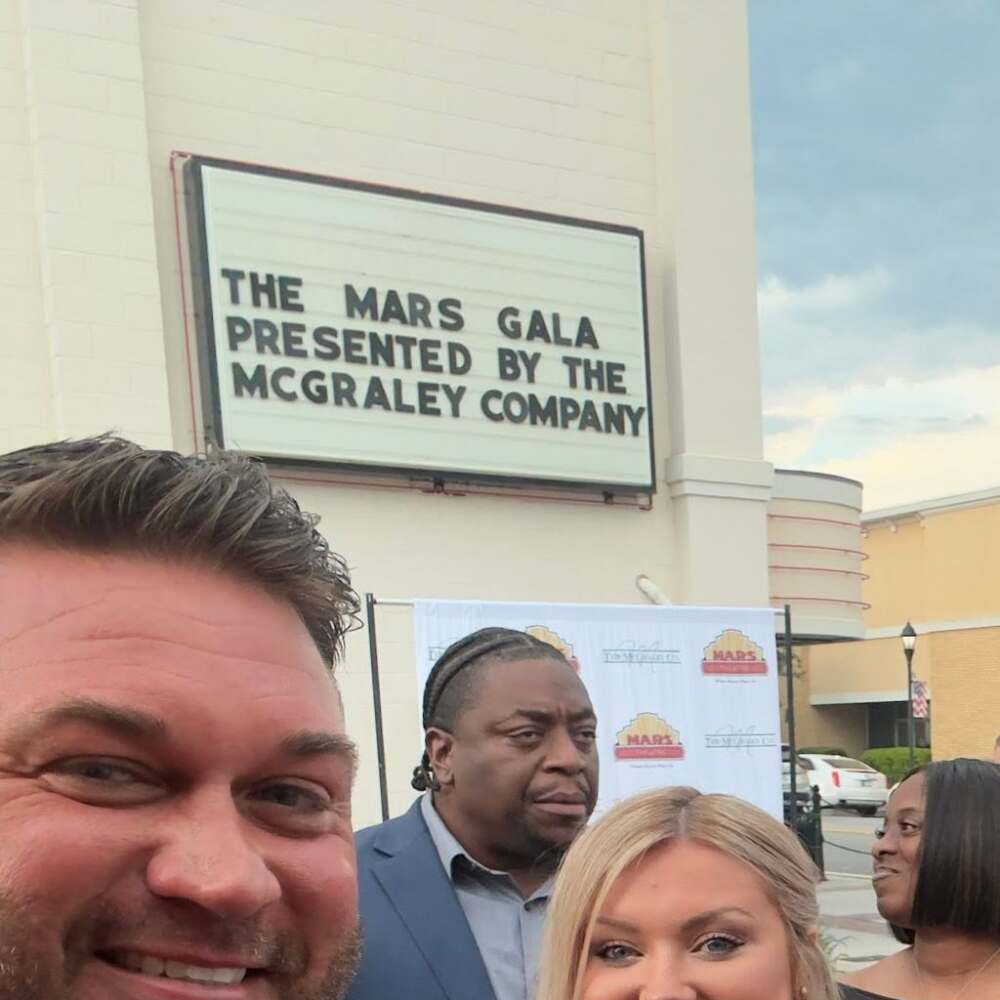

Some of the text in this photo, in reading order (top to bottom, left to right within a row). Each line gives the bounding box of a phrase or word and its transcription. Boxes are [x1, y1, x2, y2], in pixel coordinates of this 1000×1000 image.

[221, 268, 599, 349] THE MARS GALA
[225, 316, 627, 395] PRESENTED BY THE
[231, 362, 646, 437] MCGRALEY COMPANY
[712, 649, 756, 661] MARS
[626, 734, 673, 746] MARS
